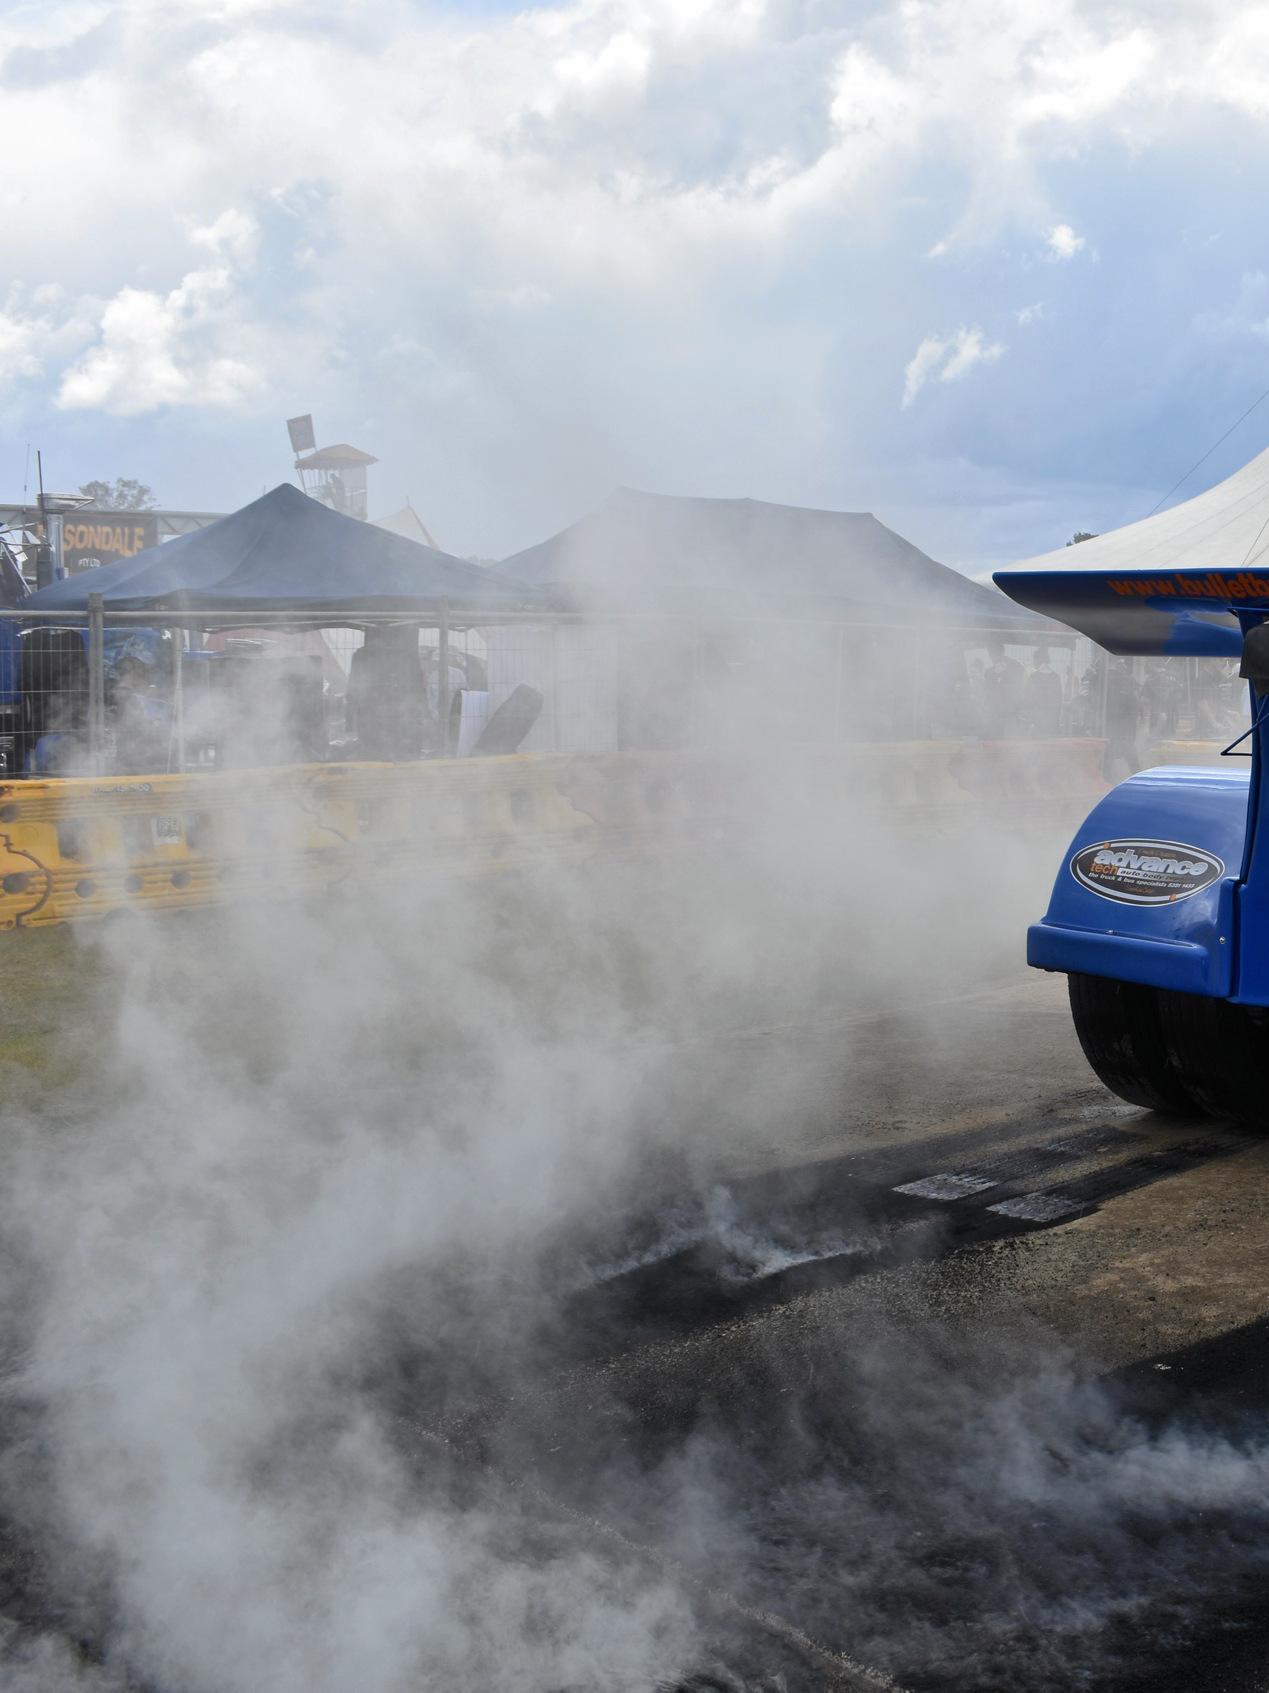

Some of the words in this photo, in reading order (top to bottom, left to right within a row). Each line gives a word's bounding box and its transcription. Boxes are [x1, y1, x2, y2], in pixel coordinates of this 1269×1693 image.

[1090, 861, 1118, 875] tech
[1120, 869, 1141, 878] auto
[1093, 849, 1209, 876] advance
